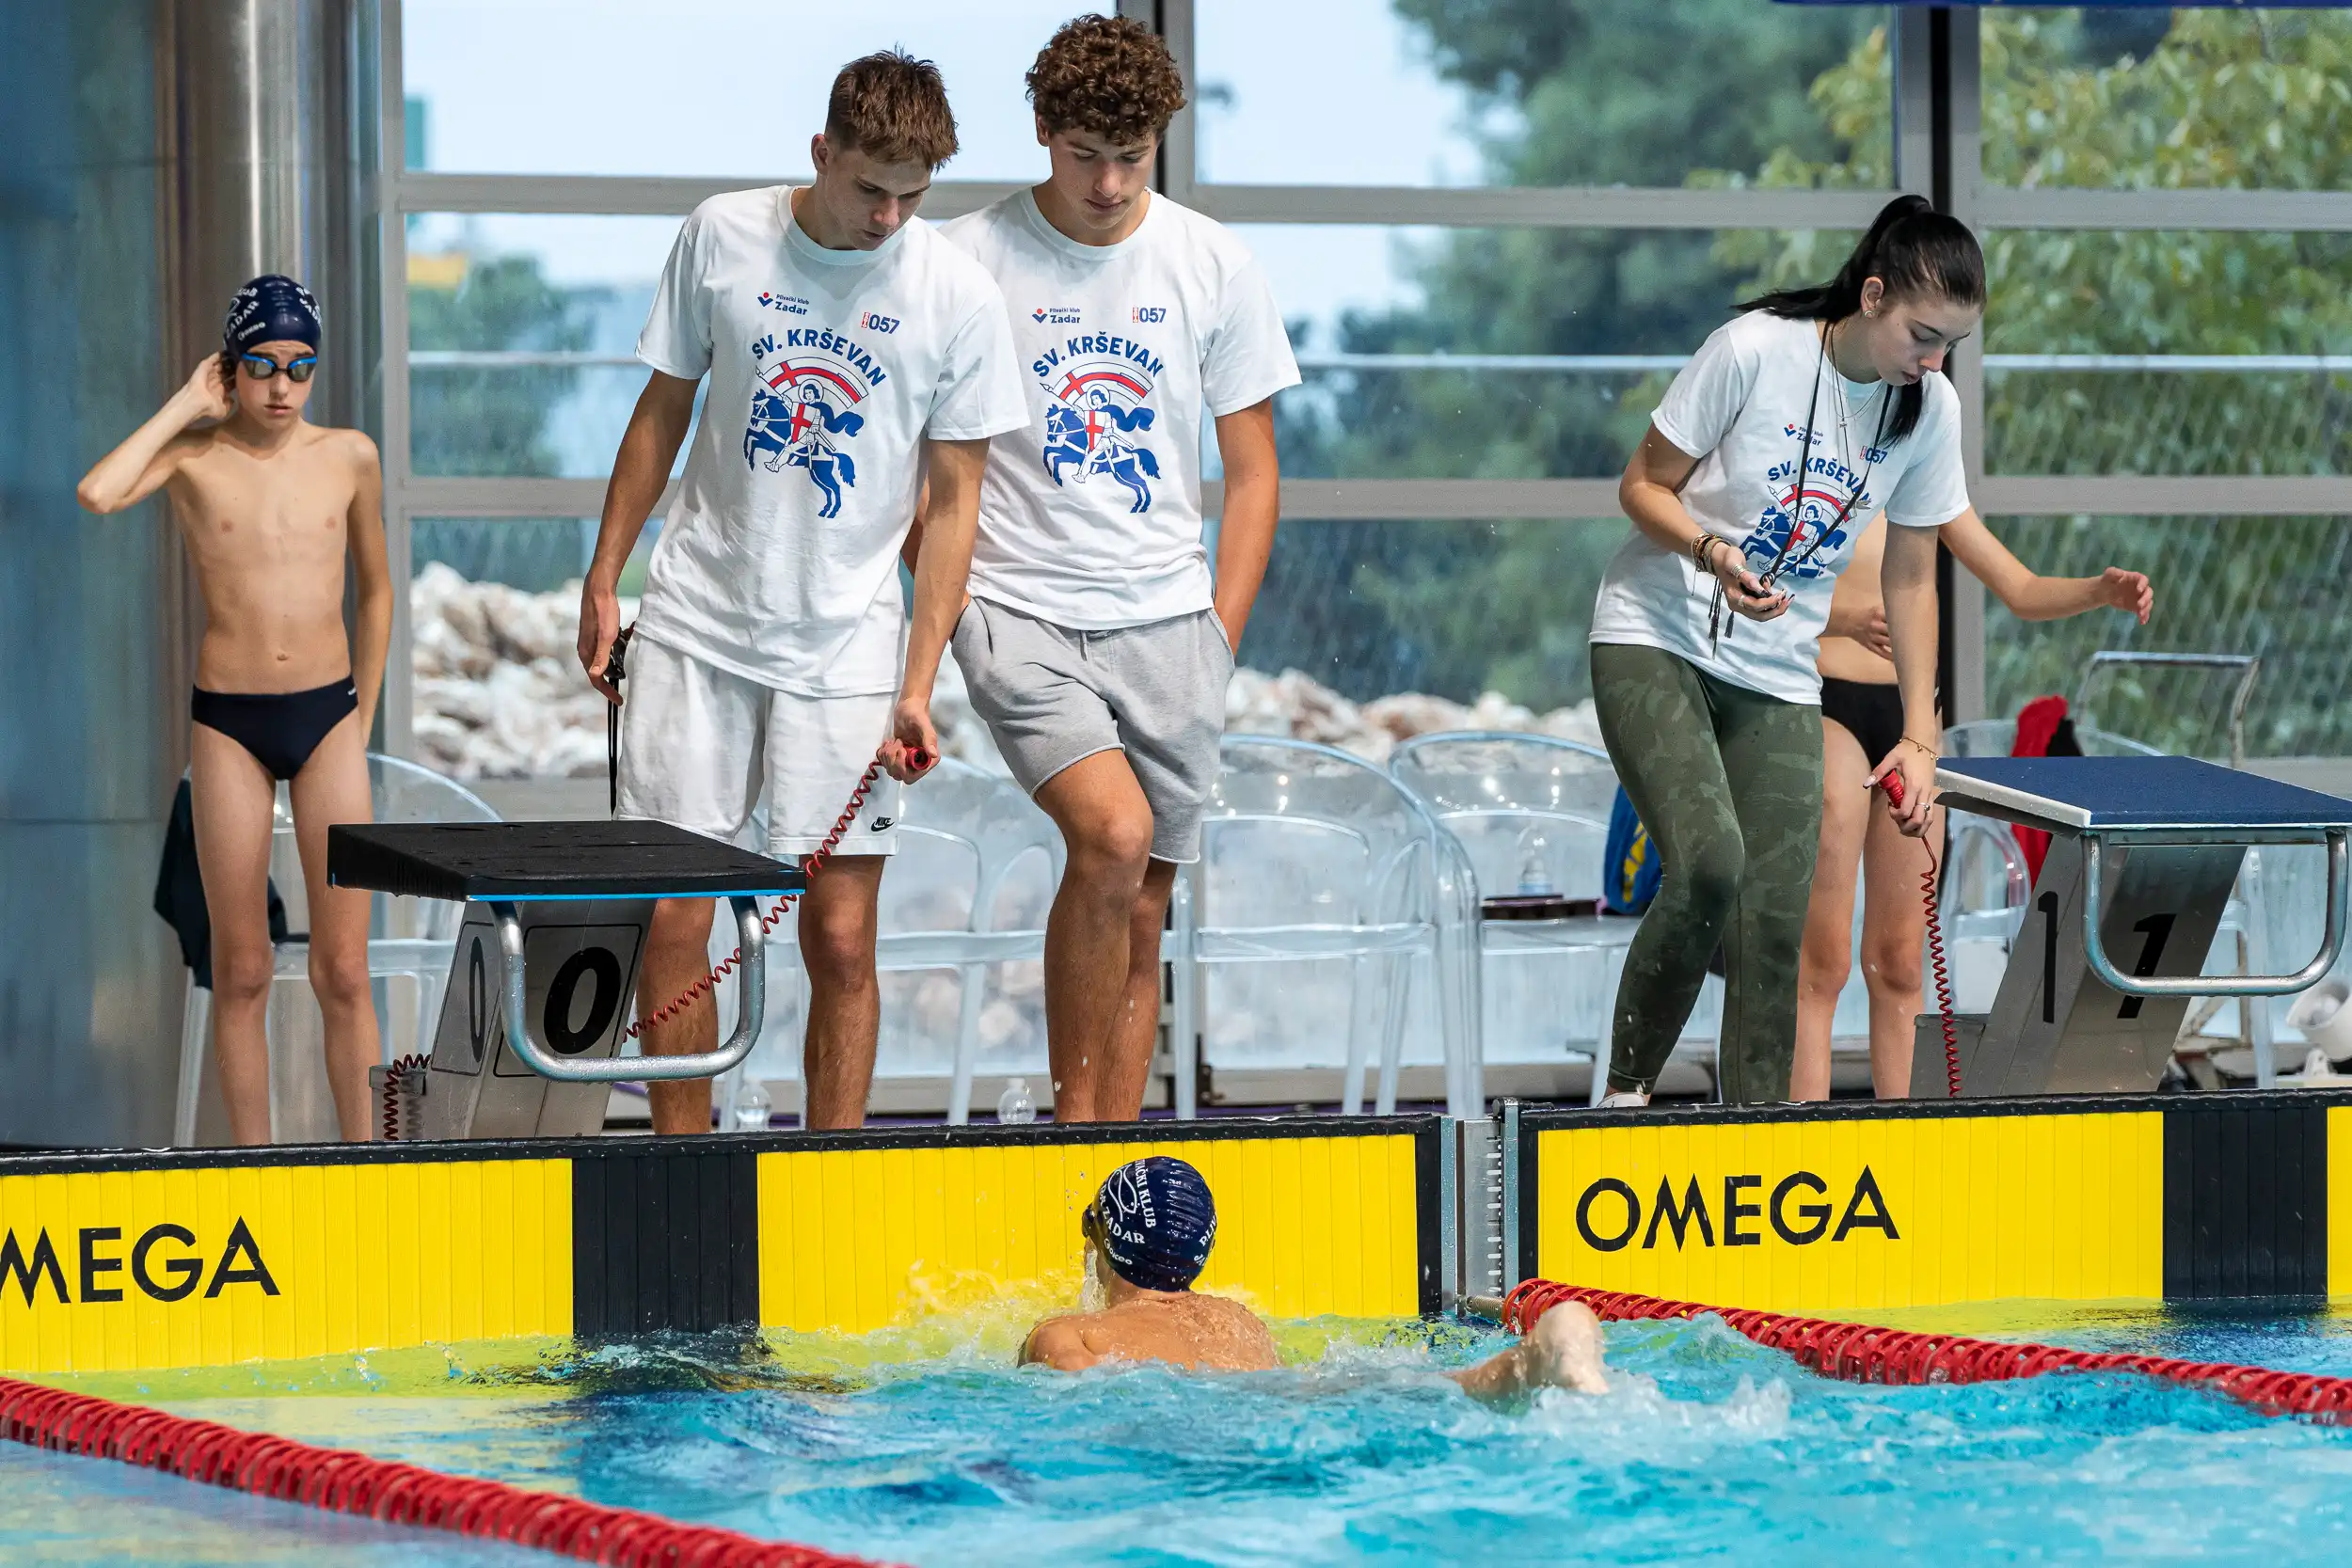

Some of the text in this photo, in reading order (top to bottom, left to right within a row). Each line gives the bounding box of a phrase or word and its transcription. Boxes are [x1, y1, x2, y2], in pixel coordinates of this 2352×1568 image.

[774, 301, 808, 316] Zadar
[797, 297, 810, 306] klub
[1050, 314, 1081, 324] Zadar
[1138, 307, 1167, 324] 057
[868, 313, 900, 334] 057
[751, 327, 887, 388] SV. KRŠEVAN
[1032, 330, 1165, 378] SV. KRŠEVAN
[1768, 460, 1798, 482] SV.
[1865, 447, 1888, 465] 057
[874, 816, 892, 827] NIKE
[2037, 890, 2058, 1024] 1
[2116, 912, 2177, 1019] 1
[469, 936, 486, 1064] 0
[543, 946, 622, 1055] 0
[1102, 1205, 1146, 1244] ZADAR
[1138, 1189, 1157, 1229] KLUB
[1575, 1164, 1901, 1254] OMEGA
[0, 1214, 281, 1310] MEGA
